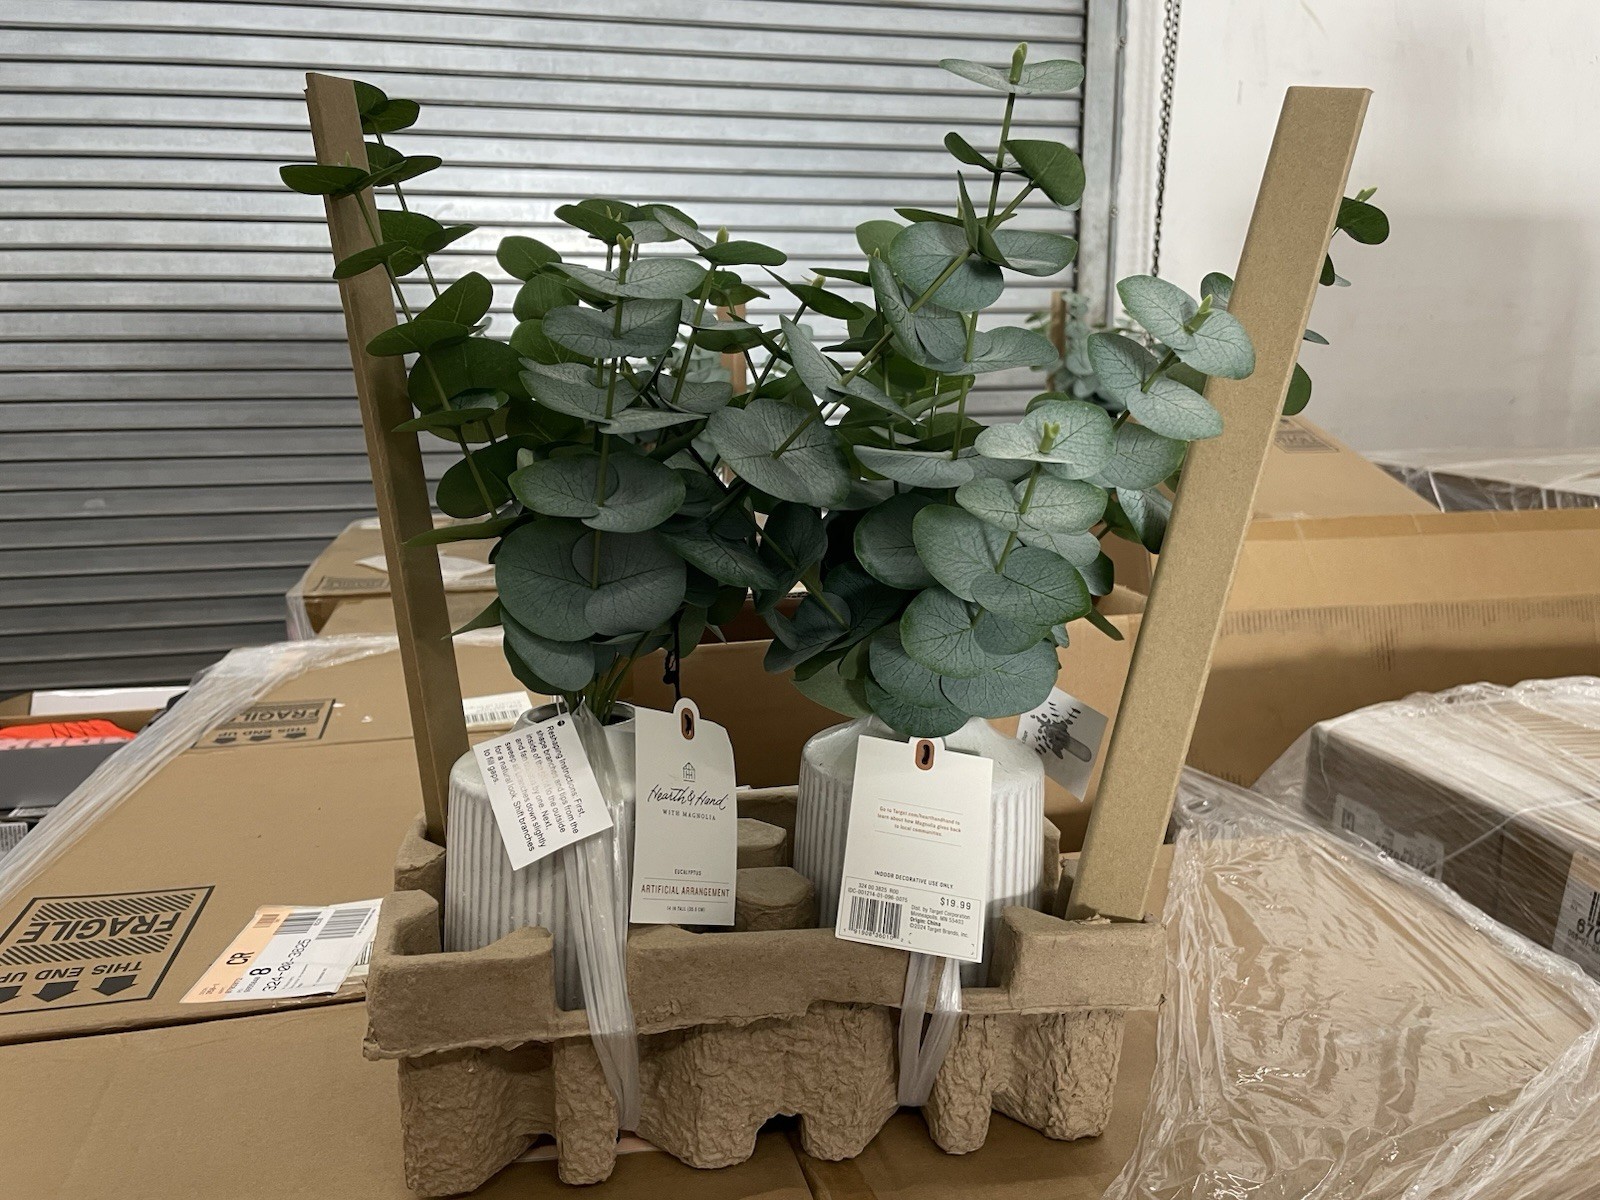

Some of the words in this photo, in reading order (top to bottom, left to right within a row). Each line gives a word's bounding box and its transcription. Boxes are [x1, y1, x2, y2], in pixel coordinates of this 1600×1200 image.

[231, 709, 320, 722] FRAGIL
[487, 765, 498, 784] gaps.
[546, 725, 562, 759] Reshaping
[573, 798, 585, 817] First,
[515, 738, 524, 750] and
[541, 810, 552, 829] Next,
[526, 733, 536, 752] inside
[552, 807, 565, 832] outside
[536, 730, 547, 748] shape
[564, 804, 574, 821] from
[570, 821, 578, 833] the
[504, 741, 516, 762] sweep
[525, 802, 536, 821] down
[532, 821, 545, 847] slightly
[647, 784, 688, 805] Hearth
[694, 790, 728, 811] Hand
[500, 761, 512, 783] natural
[513, 800, 523, 817] Shift
[518, 816, 534, 851] branches
[662, 808, 680, 817] WITH
[682, 810, 716, 821] MAGNOLIA
[674, 868, 702, 876] EUCALYPTUS
[874, 870, 894, 879] INDOOR
[895, 874, 927, 885] DECORATIVE
[928, 877, 938, 887] USE
[939, 880, 953, 889] ONLY
[641, 884, 679, 895] ARTIFICIAL
[680, 886, 730, 897] ARRANGEMENT
[940, 897, 971, 910] $19.99
[929, 907, 943, 916] Target
[944, 909, 971, 920] Corporation
[15, 911, 182, 944] FRAGILE
[927, 919, 941, 927] China
[927, 925, 941, 934] Target
[226, 951, 255, 965] CR
[34, 967, 86, 980] END
[92, 960, 143, 976] THIS
[249, 967, 272, 976] 8
